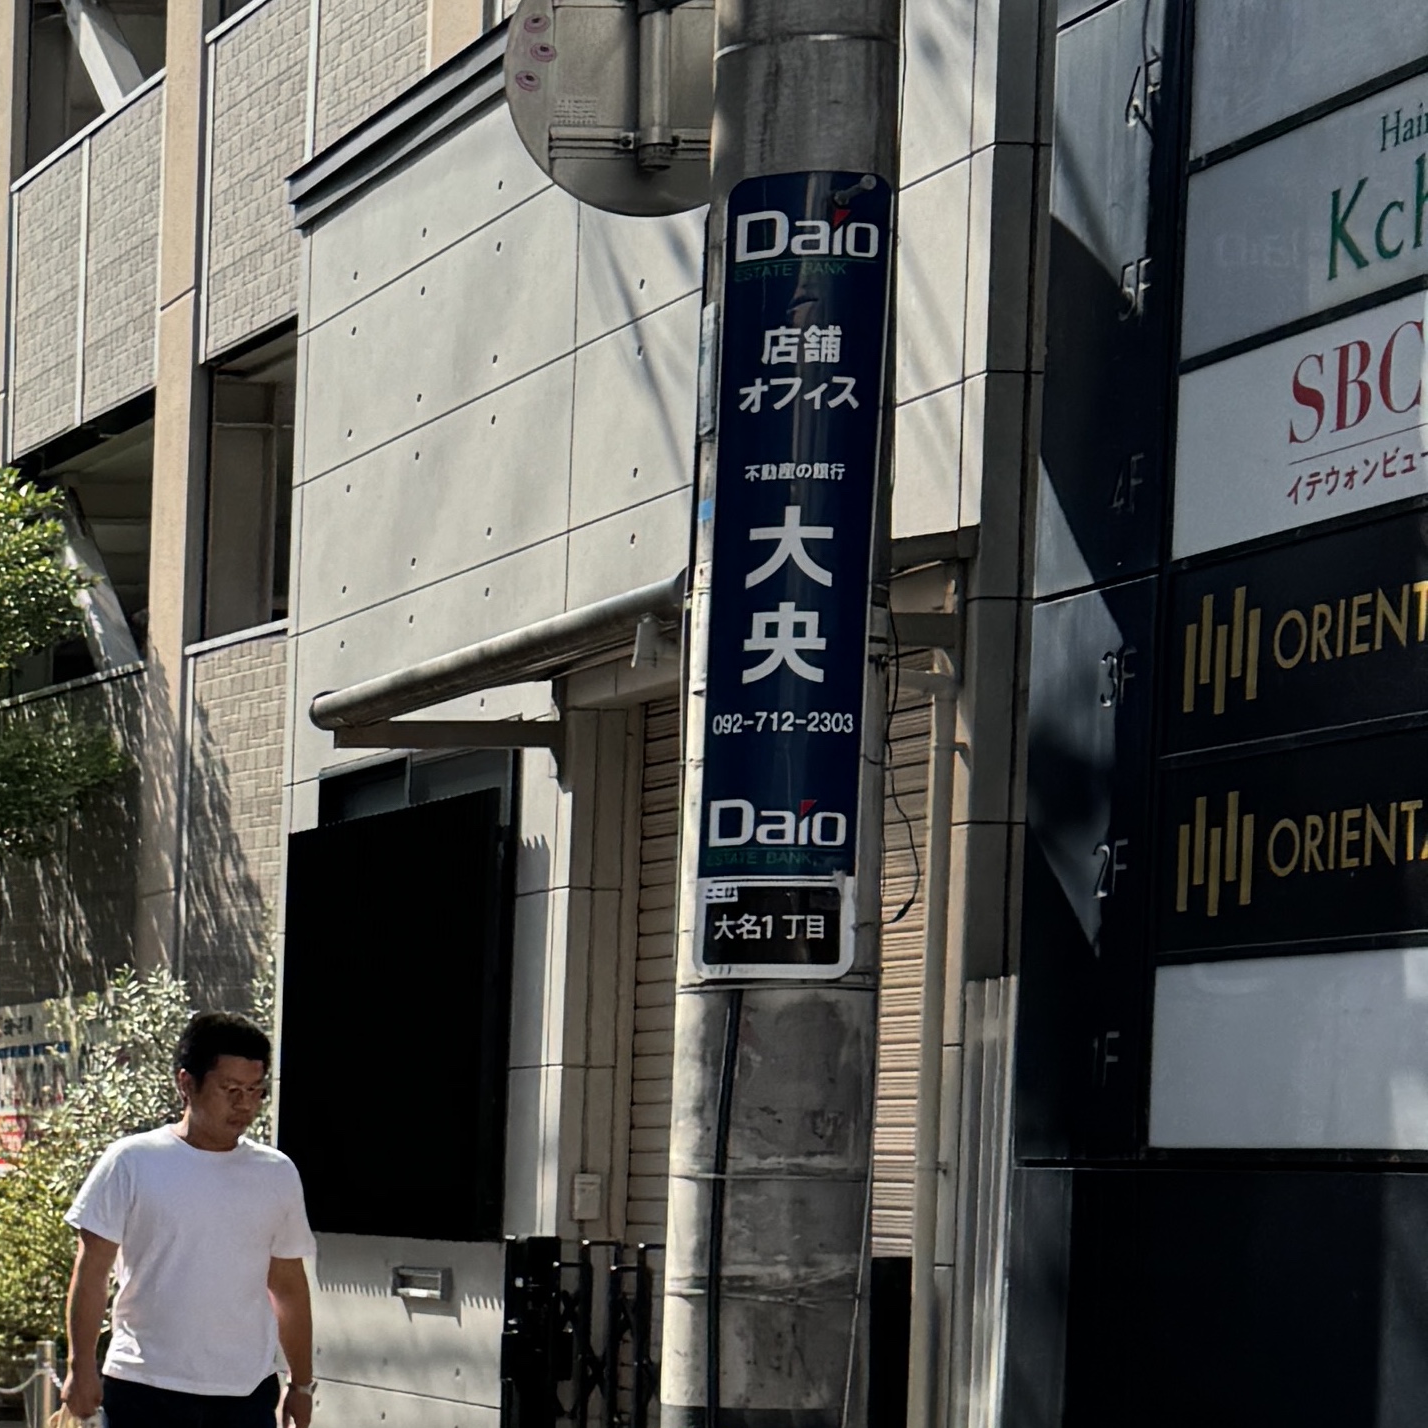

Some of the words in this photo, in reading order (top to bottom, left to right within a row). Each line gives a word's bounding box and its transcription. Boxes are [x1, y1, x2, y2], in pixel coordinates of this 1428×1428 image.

[735, 209, 879, 263] Daio
[734, 263, 793, 282] ESTATE
[801, 261, 846, 276] BANK
[761, 325, 843, 365] 店舗
[738, 375, 860, 413] オフィス
[1288, 319, 1425, 444] SBC
[744, 462, 846, 482] 不動産の銀行
[1107, 452, 1145, 515] 4F
[1099, 645, 1139, 708] 3F
[712, 711, 854, 736] 092-712-2303
[707, 799, 847, 848] Daio
[1268, 799, 1428, 877] ORIENT
[705, 849, 757, 867] ESTATE
[1092, 838, 1129, 899] 2F
[705, 887, 737, 900] ここは
[713, 914, 826, 941] 大名1丁目
